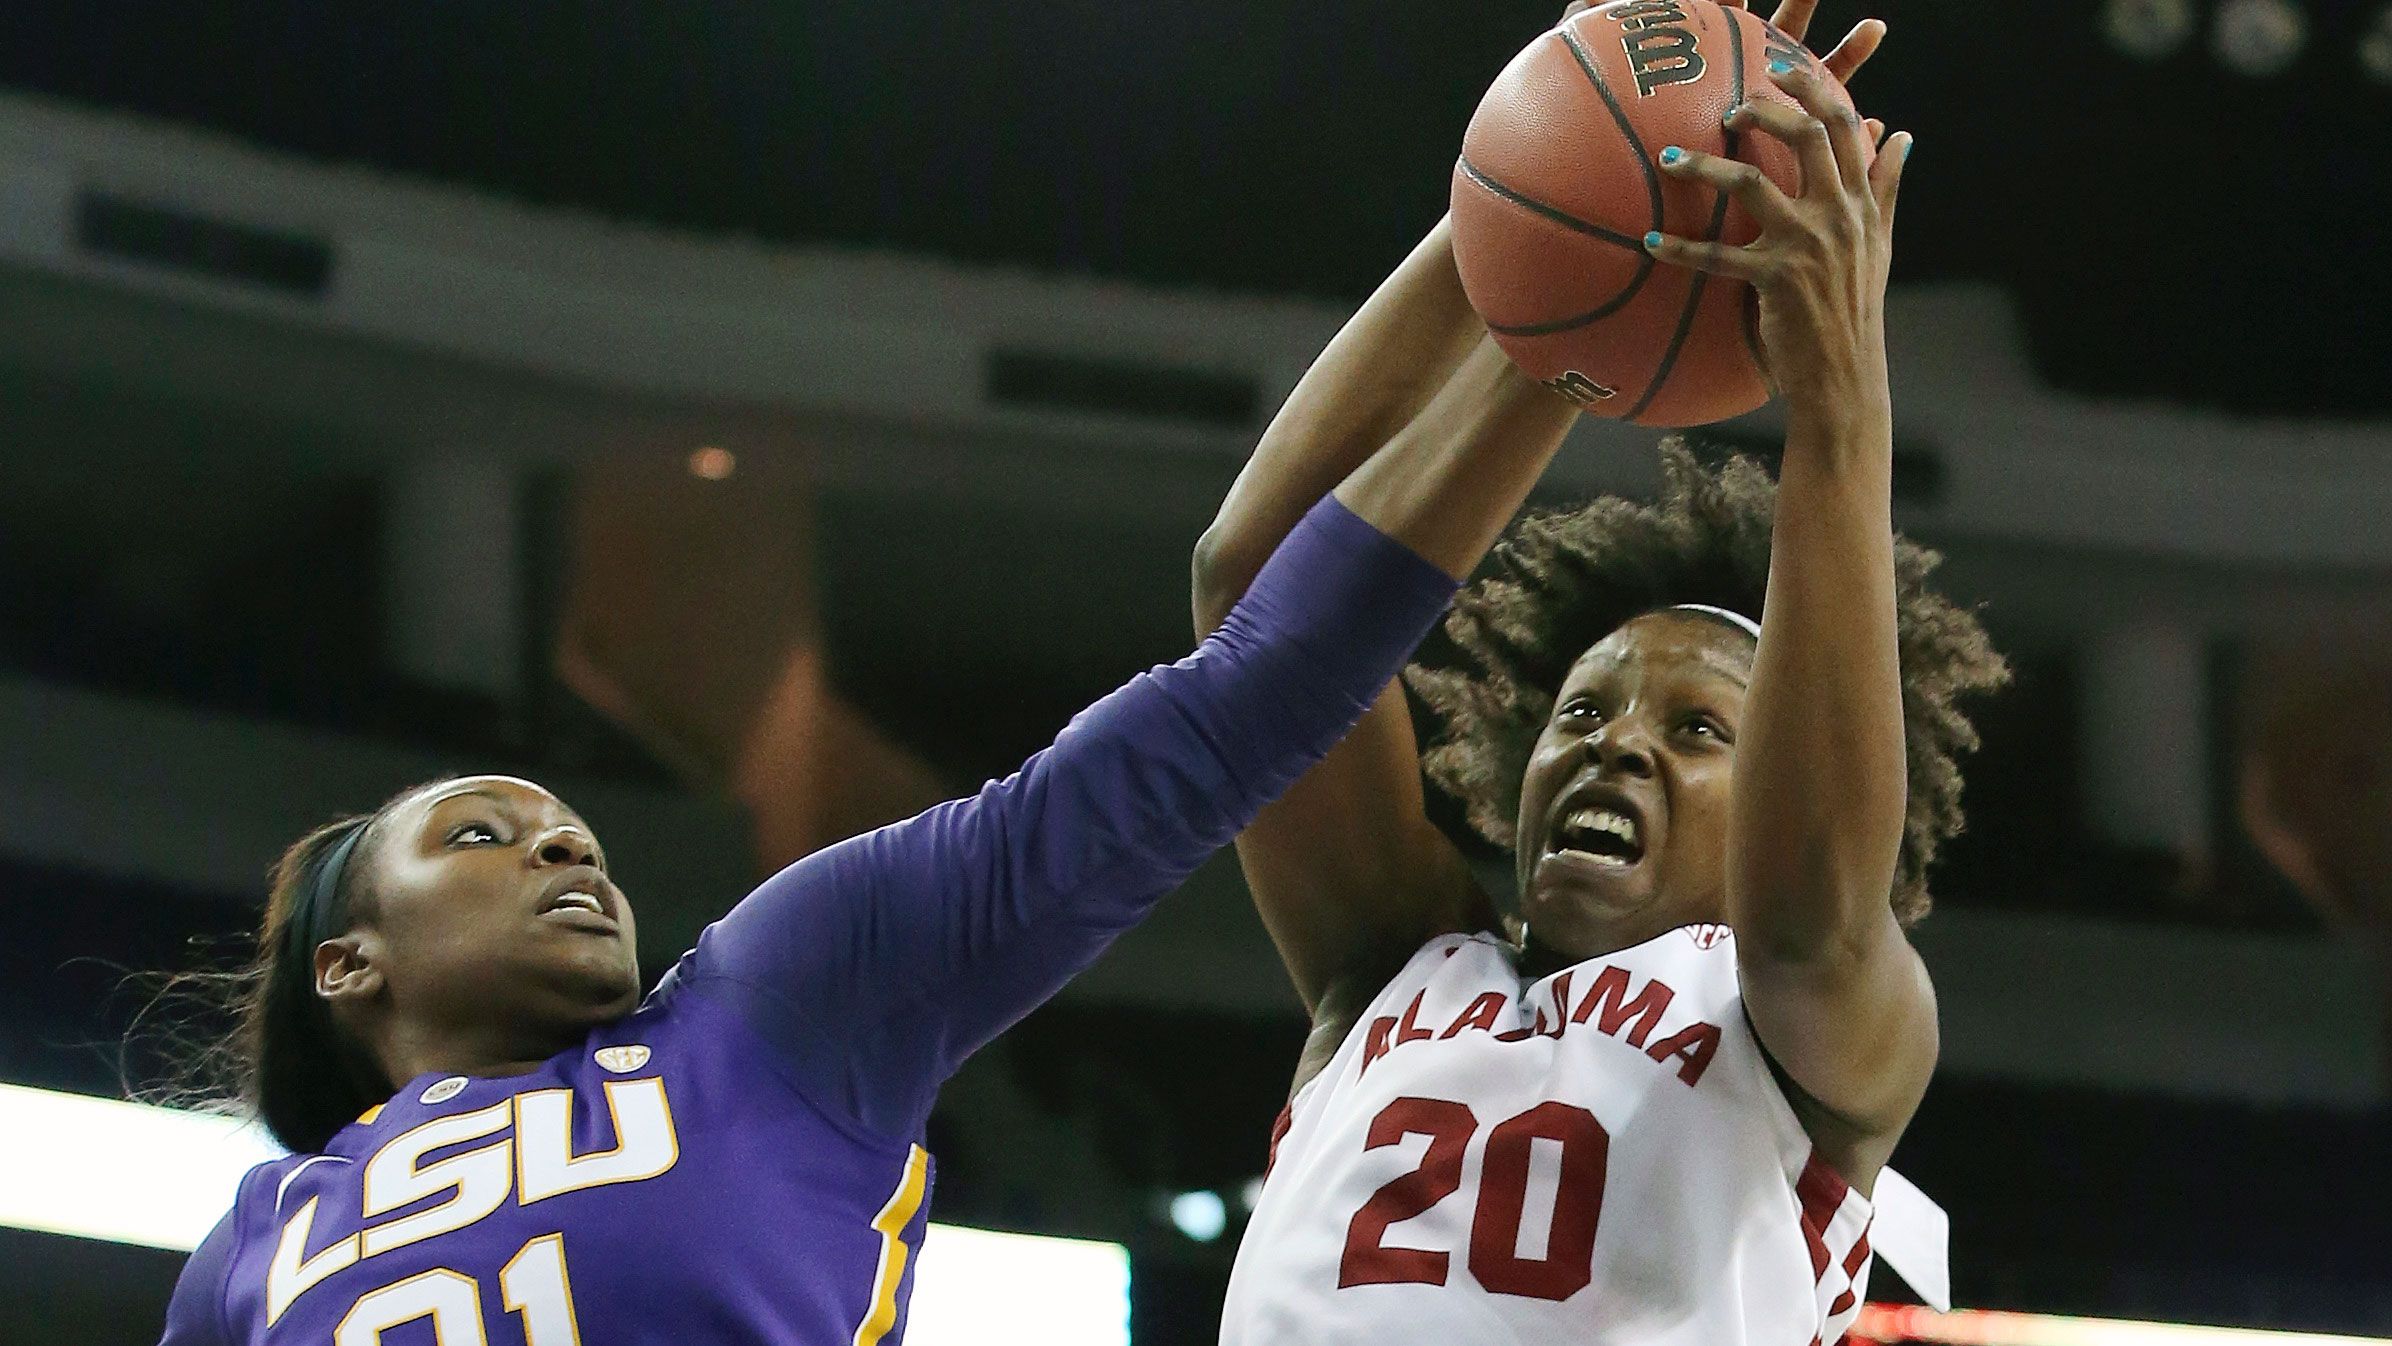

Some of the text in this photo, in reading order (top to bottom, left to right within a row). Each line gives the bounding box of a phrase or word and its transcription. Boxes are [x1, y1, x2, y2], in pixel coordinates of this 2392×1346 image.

[1355, 965, 1723, 1088] ALAMA
[266, 1076, 680, 1329] LSU
[1338, 1096, 1610, 1302] 20
